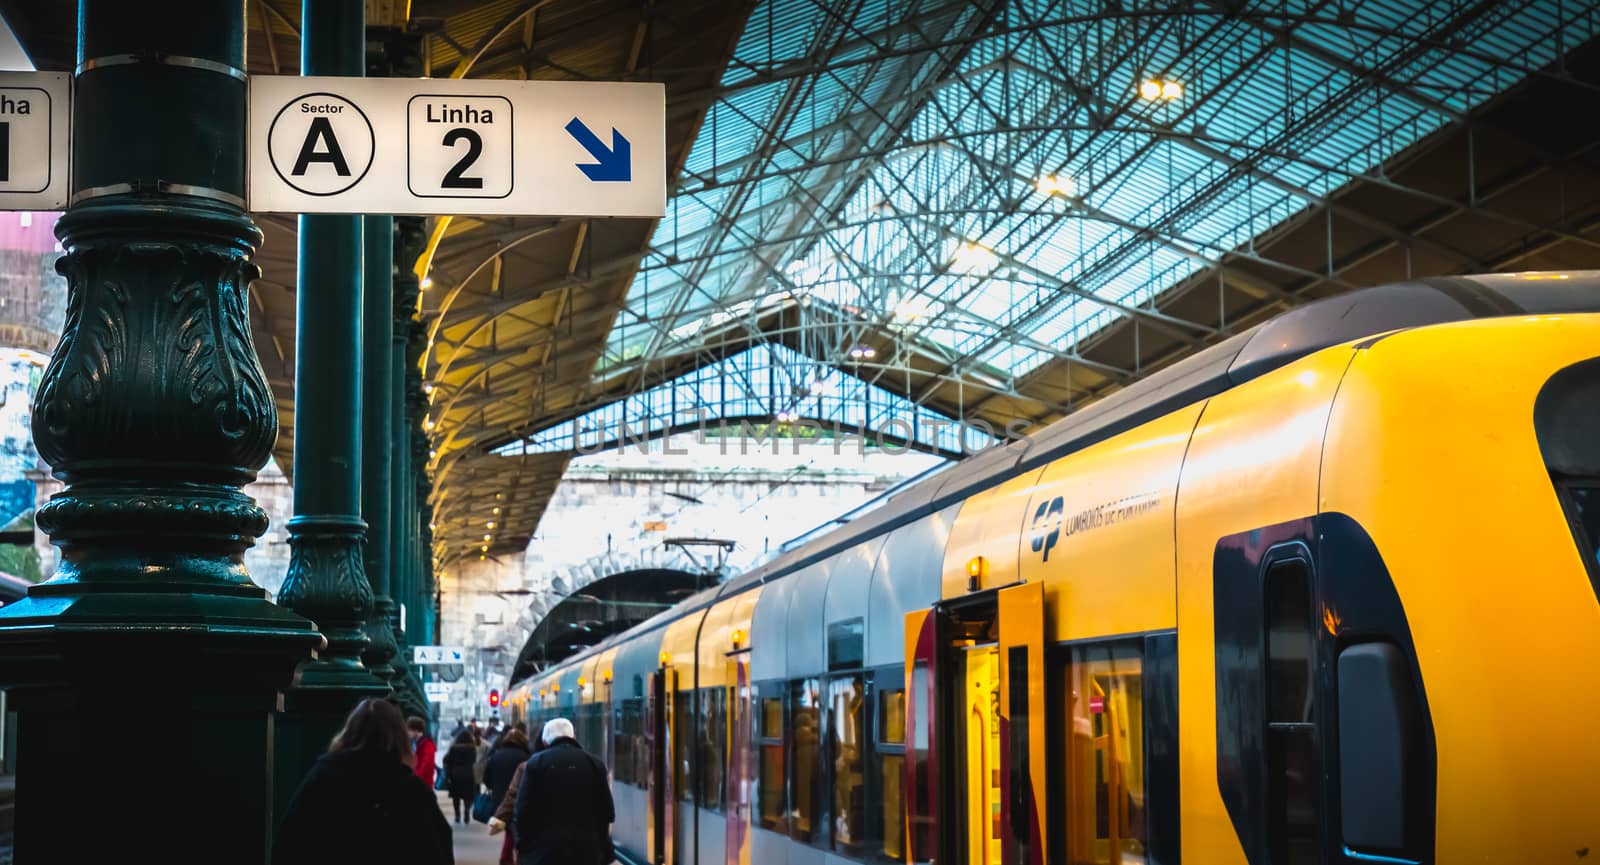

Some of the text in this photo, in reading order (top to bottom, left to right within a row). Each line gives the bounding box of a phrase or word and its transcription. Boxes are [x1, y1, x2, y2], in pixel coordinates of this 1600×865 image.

[301, 103, 344, 114] Sector
[426, 104, 494, 124] Linha
[291, 117, 352, 177] A
[441, 127, 483, 189] 2
